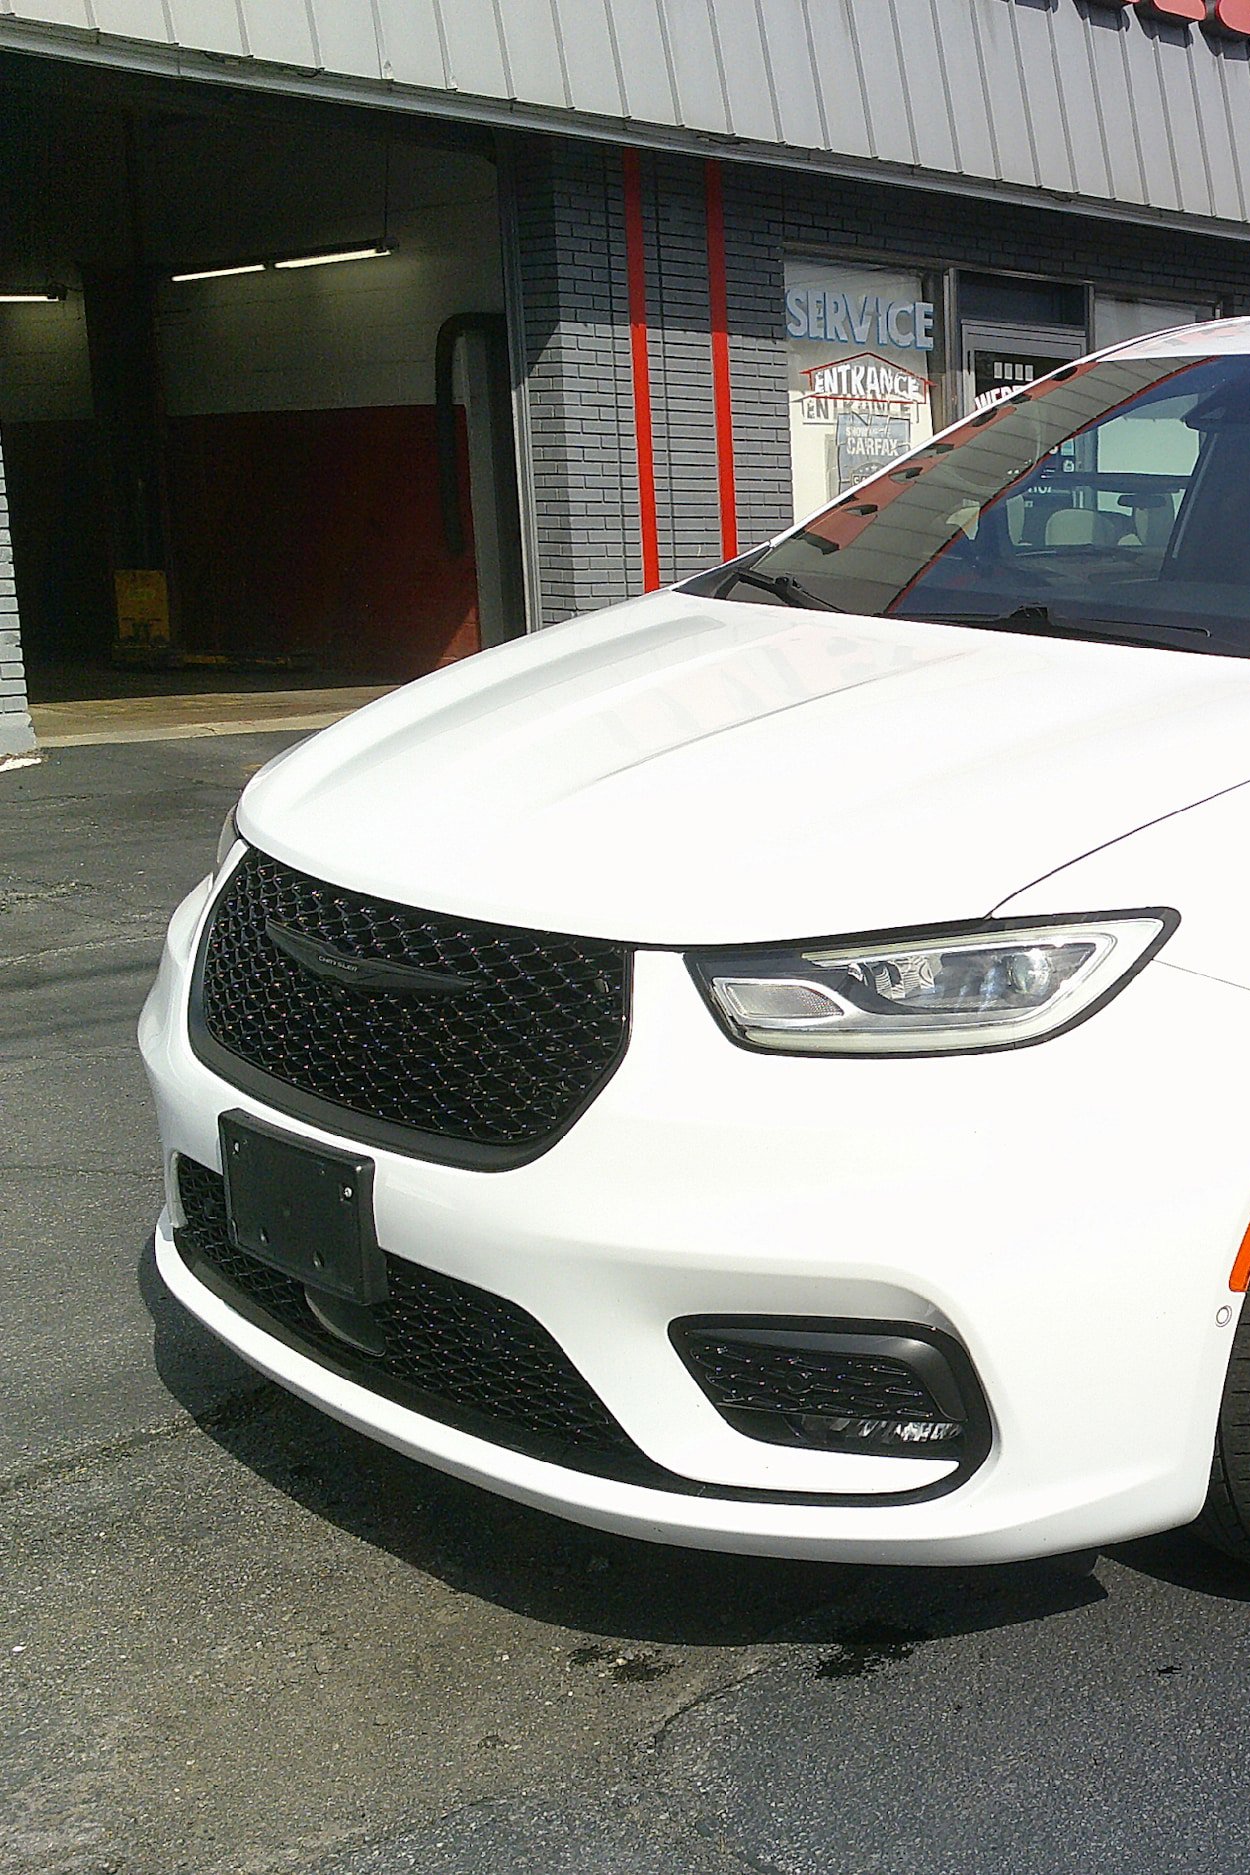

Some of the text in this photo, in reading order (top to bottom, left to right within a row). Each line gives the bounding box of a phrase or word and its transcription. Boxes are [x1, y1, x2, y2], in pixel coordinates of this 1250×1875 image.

[786, 289, 934, 351] SERVICE
[814, 363, 920, 400] ENTRANCE
[846, 437, 899, 456] CARFAX
[319, 955, 358, 972] CHRYSLER
